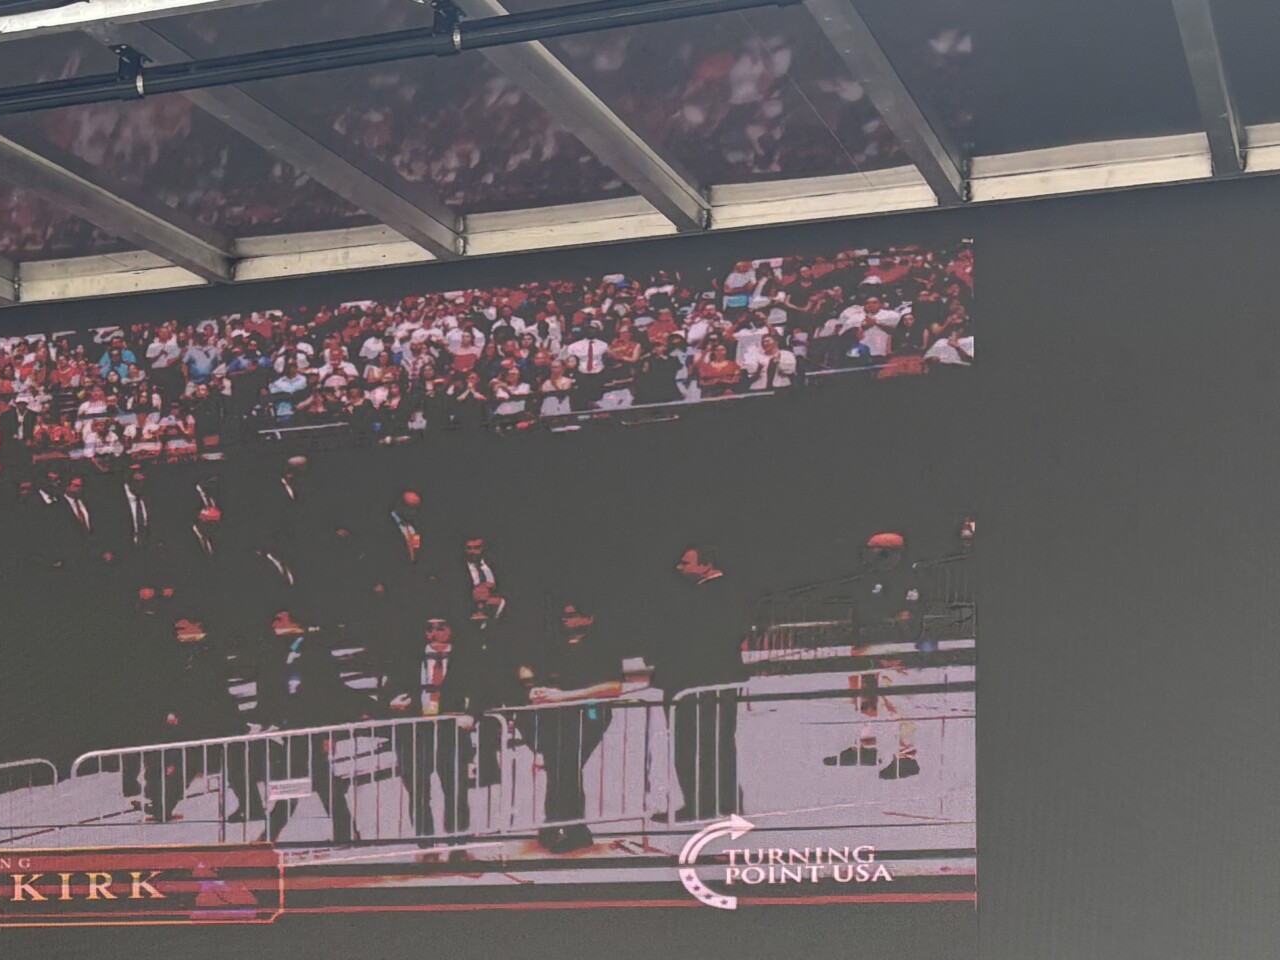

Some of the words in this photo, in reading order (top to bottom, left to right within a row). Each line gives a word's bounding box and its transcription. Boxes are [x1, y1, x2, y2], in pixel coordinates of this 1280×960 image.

[722, 845, 876, 866] TURNING
[725, 865, 825, 885] POINT
[833, 862, 894, 882] USA
[9, 870, 169, 902] KIRK
